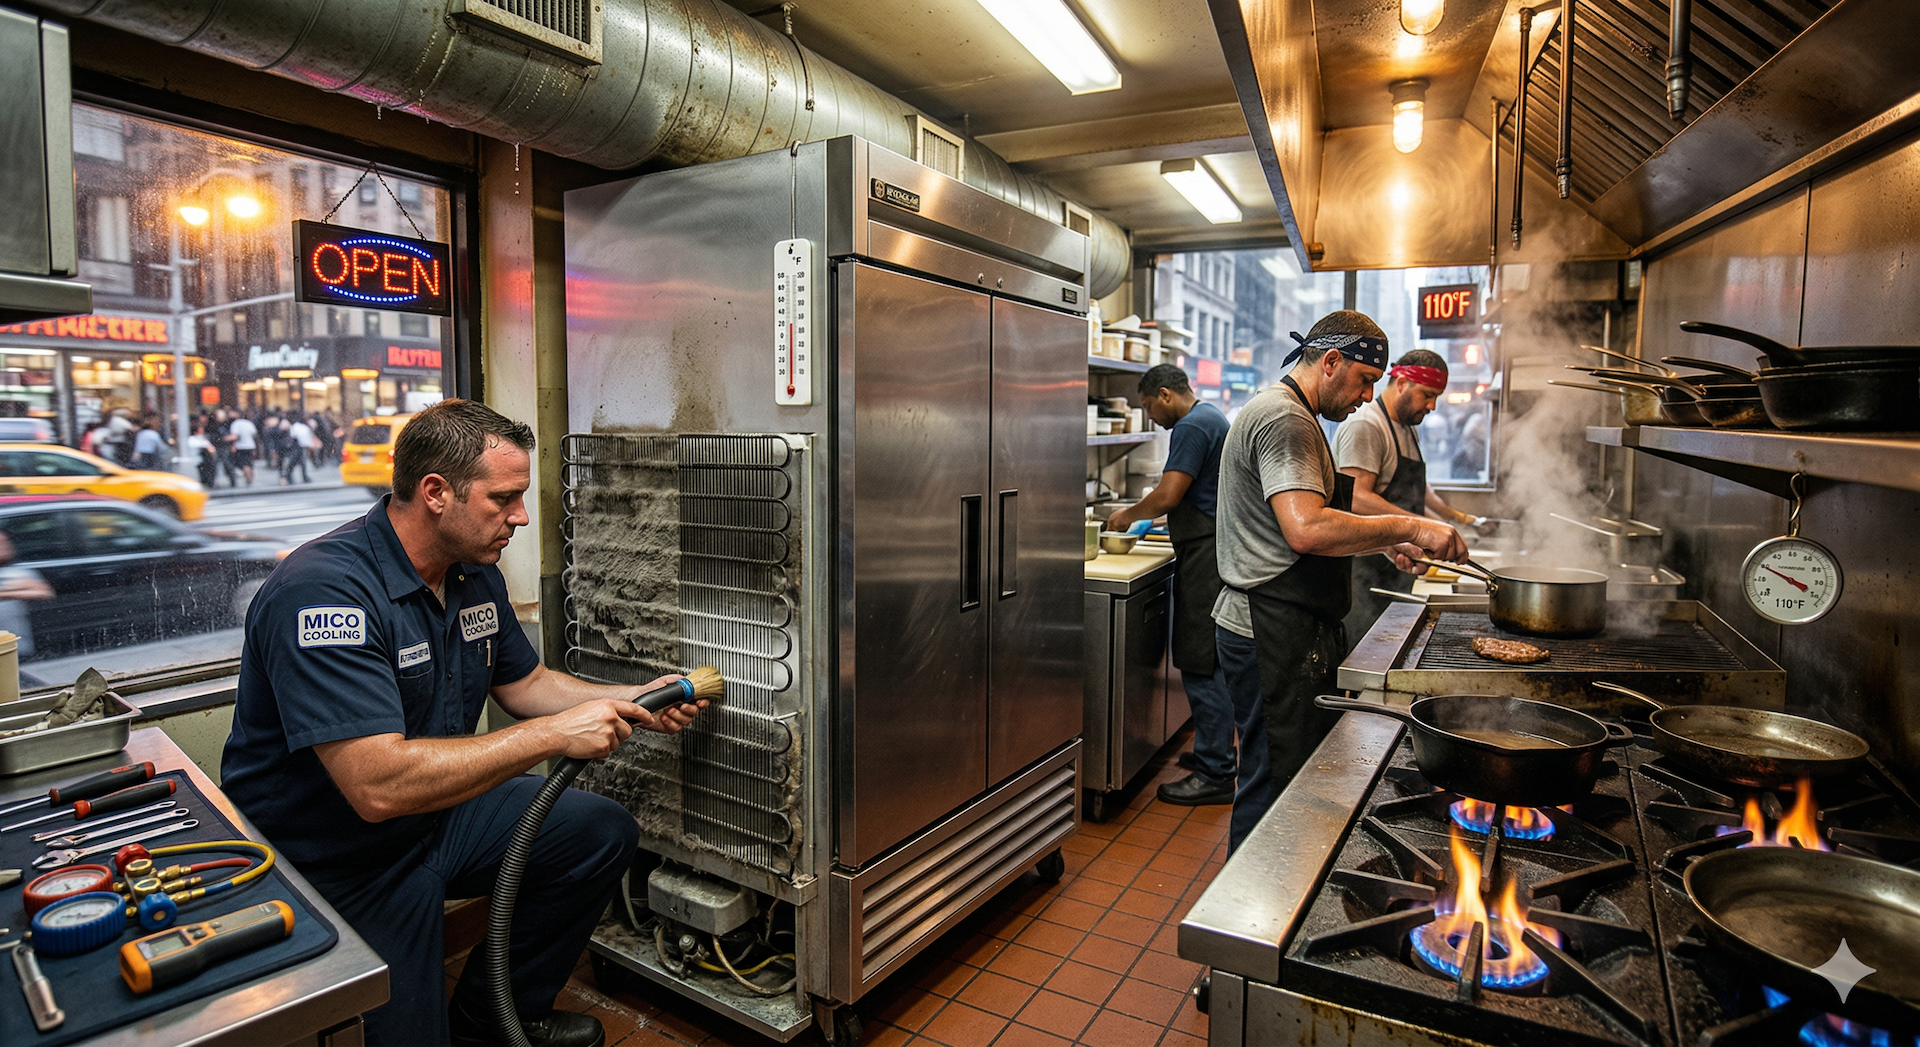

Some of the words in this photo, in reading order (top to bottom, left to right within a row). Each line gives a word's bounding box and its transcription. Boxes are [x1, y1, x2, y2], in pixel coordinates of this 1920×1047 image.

[311, 242, 440, 296] OPEN
[1423, 290, 1472, 319] 110°F
[1776, 597, 1805, 609] 110°F
[304, 613, 360, 630] MICO
[462, 607, 494, 628] MICO
[303, 630, 361, 641] COOLING
[465, 620, 497, 637] COOLING
